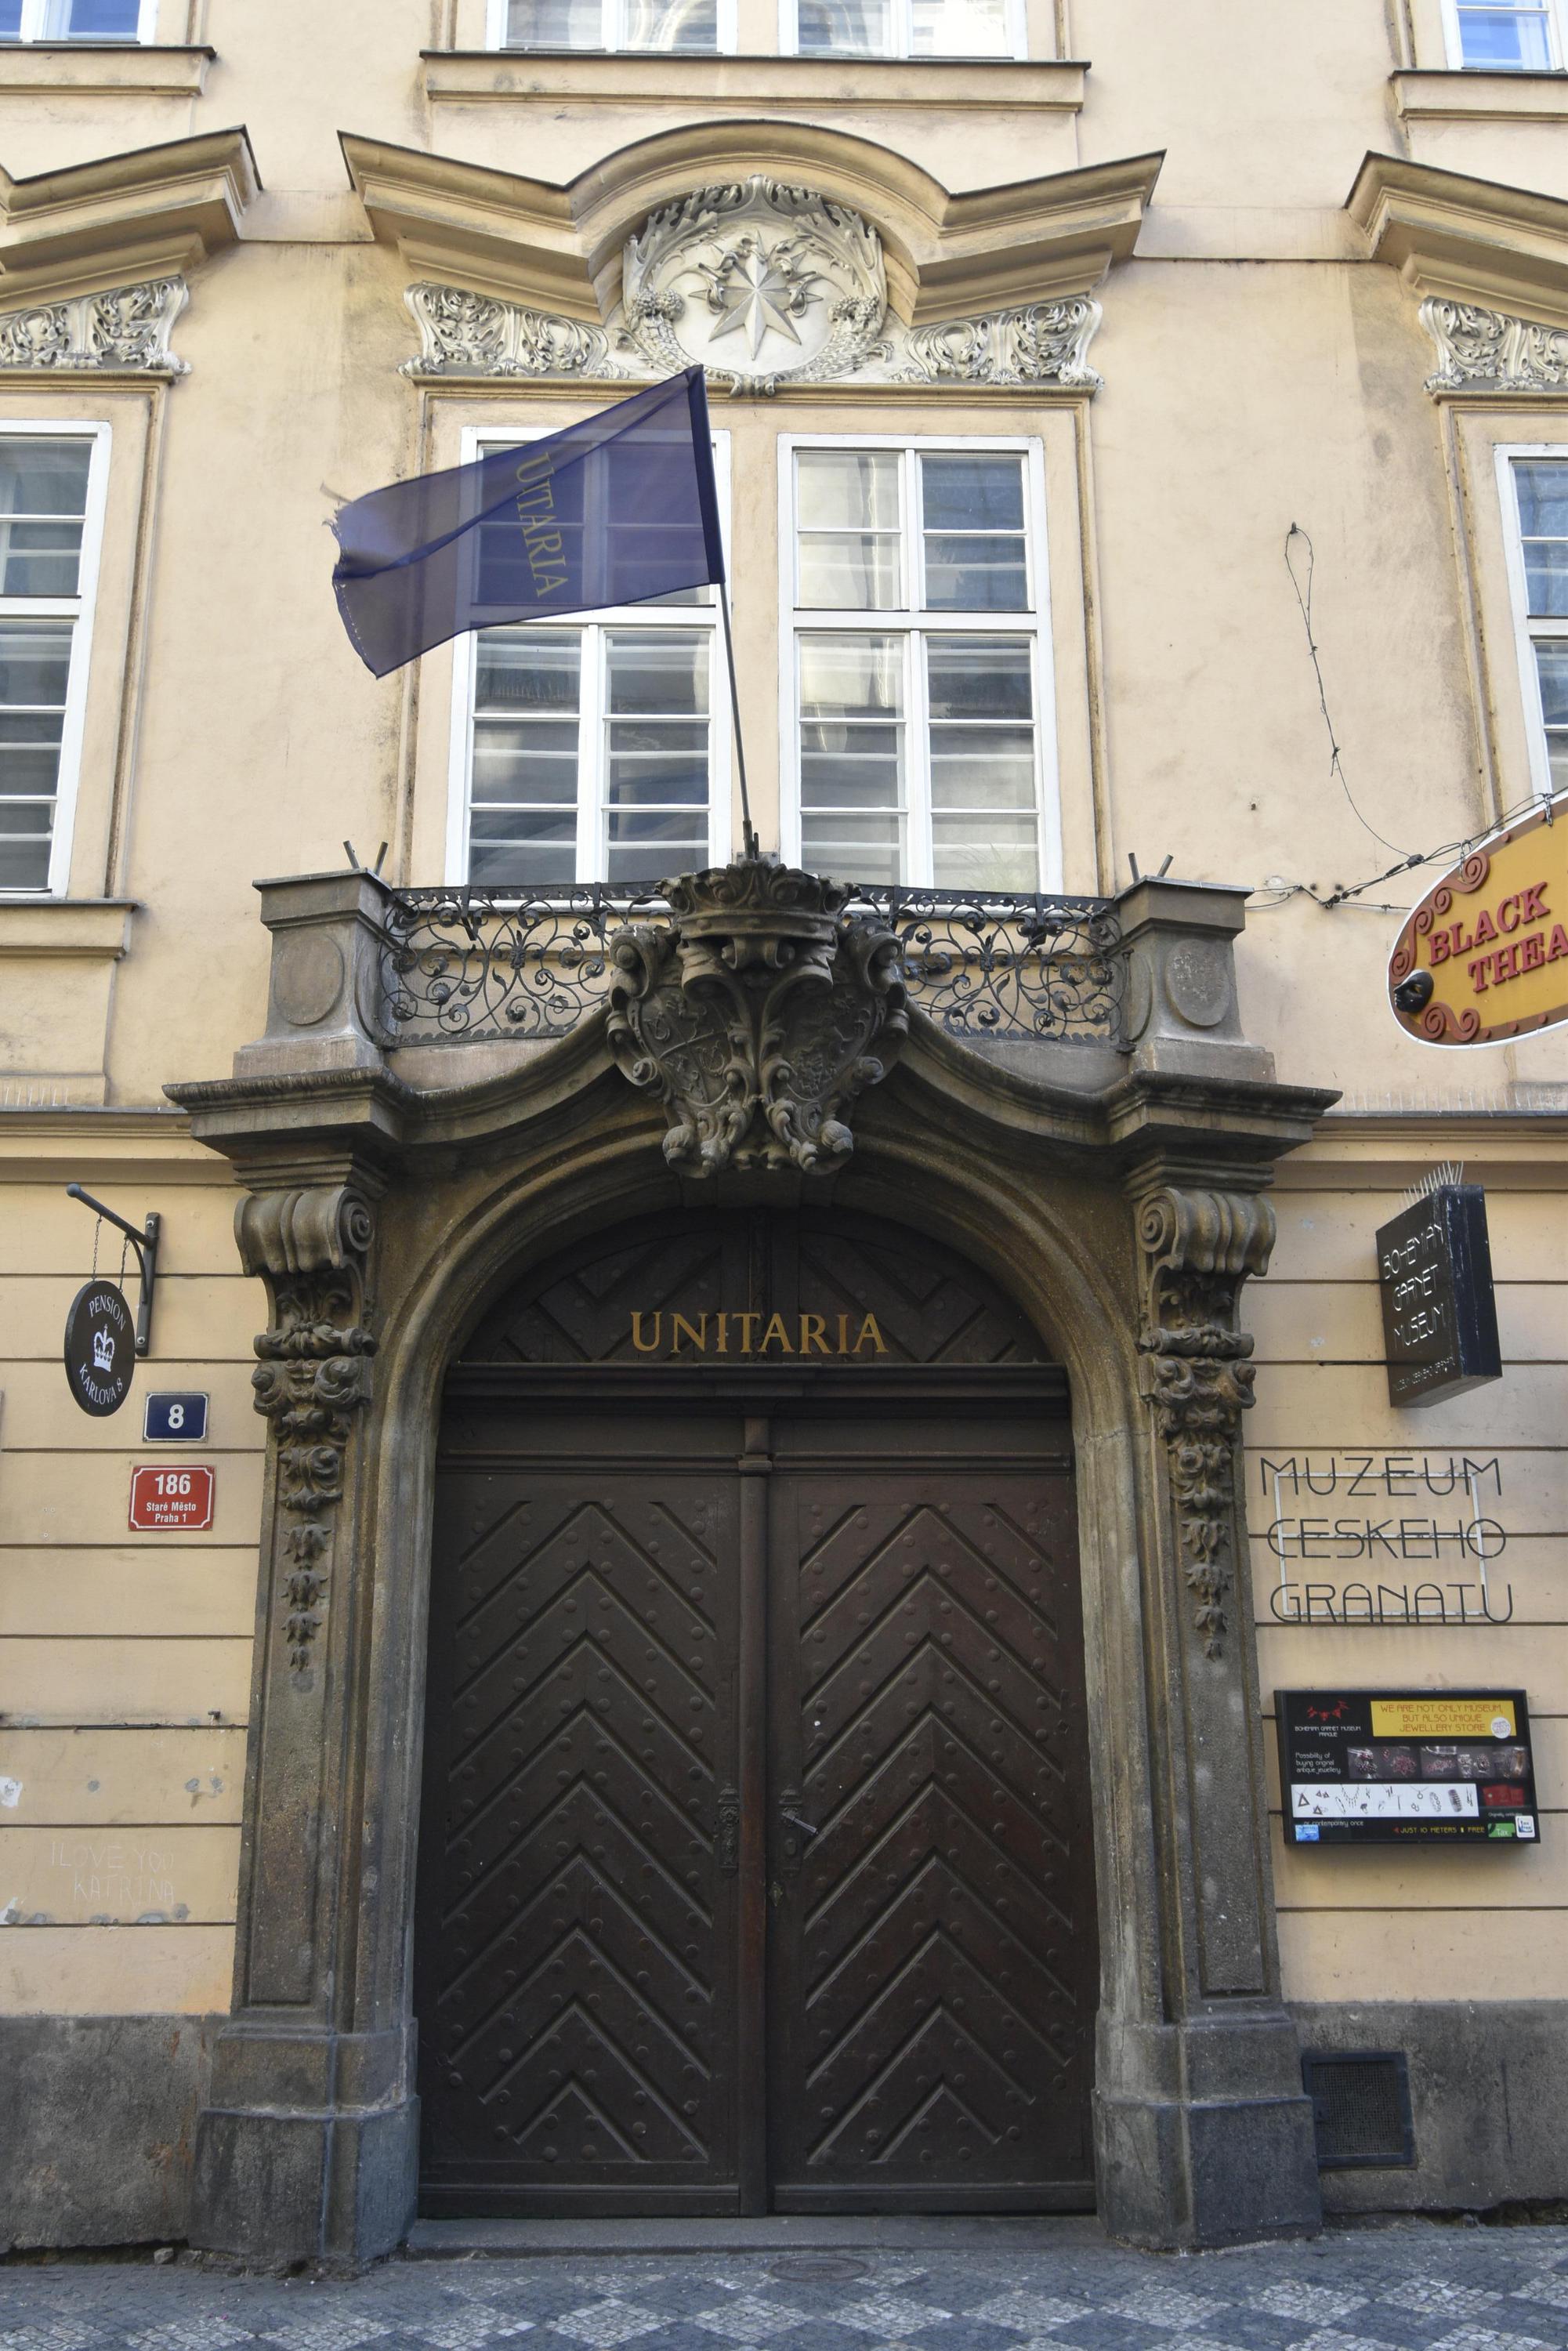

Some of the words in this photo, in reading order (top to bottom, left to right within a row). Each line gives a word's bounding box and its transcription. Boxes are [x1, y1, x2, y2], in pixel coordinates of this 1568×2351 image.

[1427, 882, 1551, 965] BLACK
[89, 1295, 125, 1331] PENSION
[630, 1311, 889, 1354] UNITARIA
[80, 1364, 117, 1405] KARLOVA
[117, 1378, 122, 1392] 8
[168, 1404, 184, 1429] 8
[155, 1474, 191, 1495] 186
[1260, 1457, 1502, 1496] MUZEUM
[147, 1502, 168, 1511] Staré
[172, 1502, 197, 1511] Město
[155, 1513, 179, 1523] Praha
[183, 1513, 186, 1523] 1
[1267, 1518, 1506, 1559] CESKEHO
[1270, 1583, 1513, 1624] GRANATU
[1400, 1723, 1453, 1732] JEWELLERY
[1456, 1723, 1486, 1732] STORE
[1403, 1714, 1419, 1722] BUT
[1422, 1714, 1447, 1722] ALSO
[1450, 1714, 1482, 1722] UNIQUE
